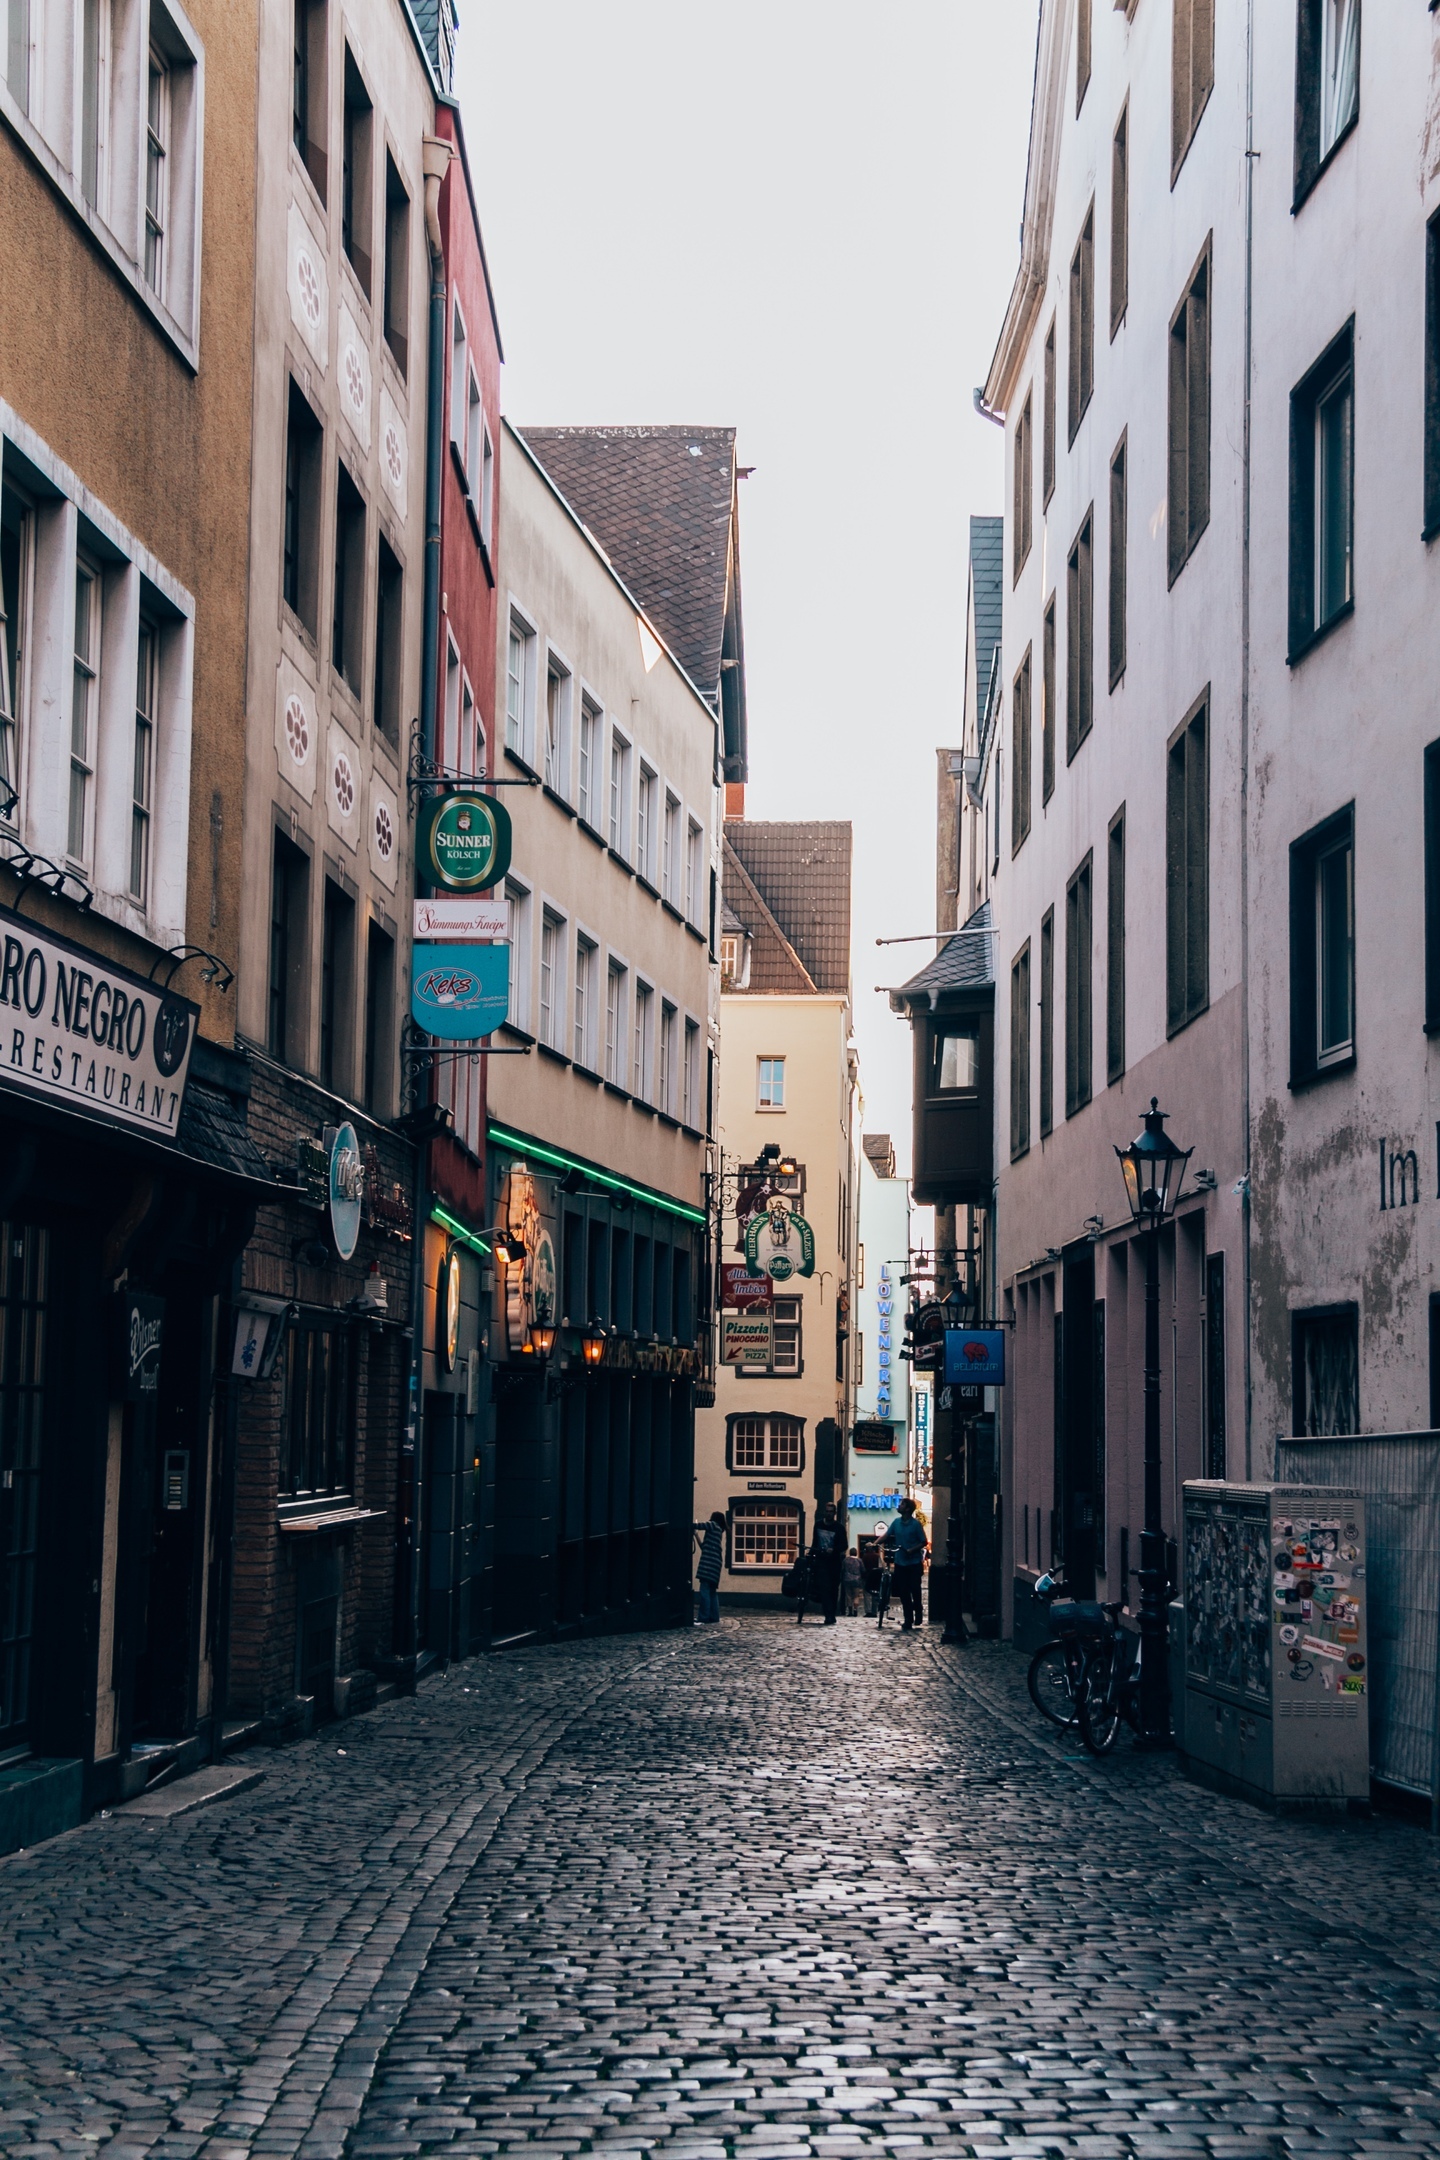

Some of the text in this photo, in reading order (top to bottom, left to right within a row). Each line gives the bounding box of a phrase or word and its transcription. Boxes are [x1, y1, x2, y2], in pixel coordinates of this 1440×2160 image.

[437, 831, 491, 849] SÜNNER
[447, 849, 480, 859] KÖLSCH
[423, 972, 472, 998] Keks
[51, 960, 147, 1061] NEGRO
[10, 1028, 179, 1123] RESTAURANT
[1379, 1137, 1419, 1211] Im
[748, 1216, 768, 1258] BIERHAUS
[733, 1282, 767, 1295] Imbiss
[726, 1322, 769, 1334] Pizzeria
[726, 1335, 769, 1344] PINOCCHIO
[876, 1264, 893, 1419] LÖWENBRÄU
[130, 1307, 161, 1377] Pilsner
[745, 1352, 767, 1360] PIZZA
[917, 1393, 926, 1422] HOTEL
